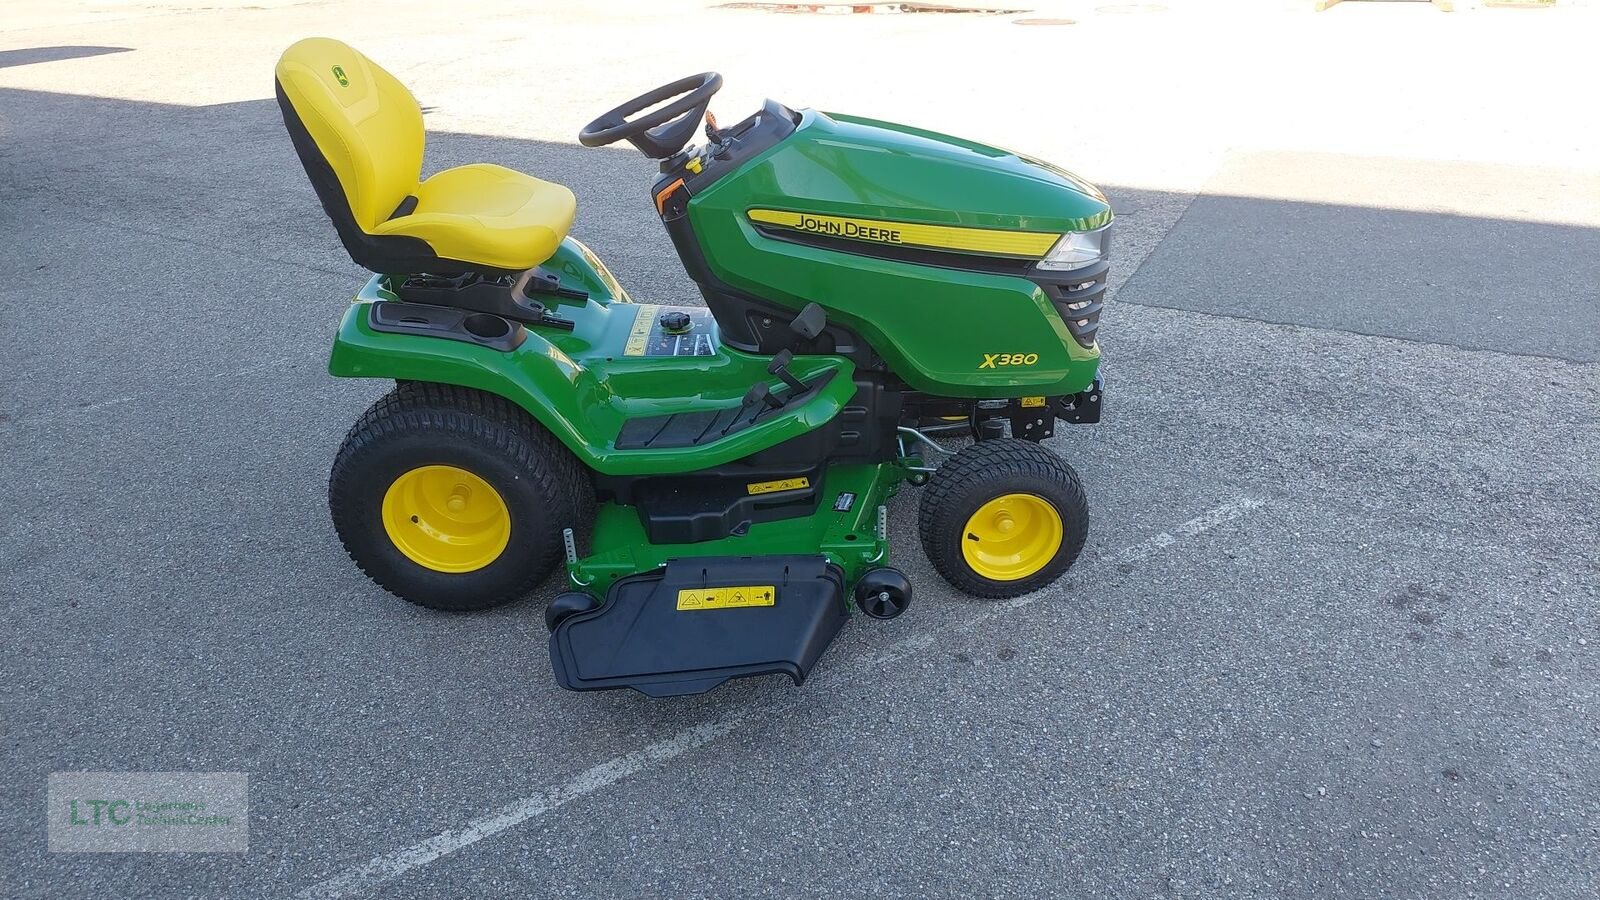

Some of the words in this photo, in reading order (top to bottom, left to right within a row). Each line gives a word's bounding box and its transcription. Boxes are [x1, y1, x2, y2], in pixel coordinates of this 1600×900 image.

[795, 215, 841, 234] JOHN
[845, 221, 901, 241] DEERE
[978, 353, 1039, 369] X380
